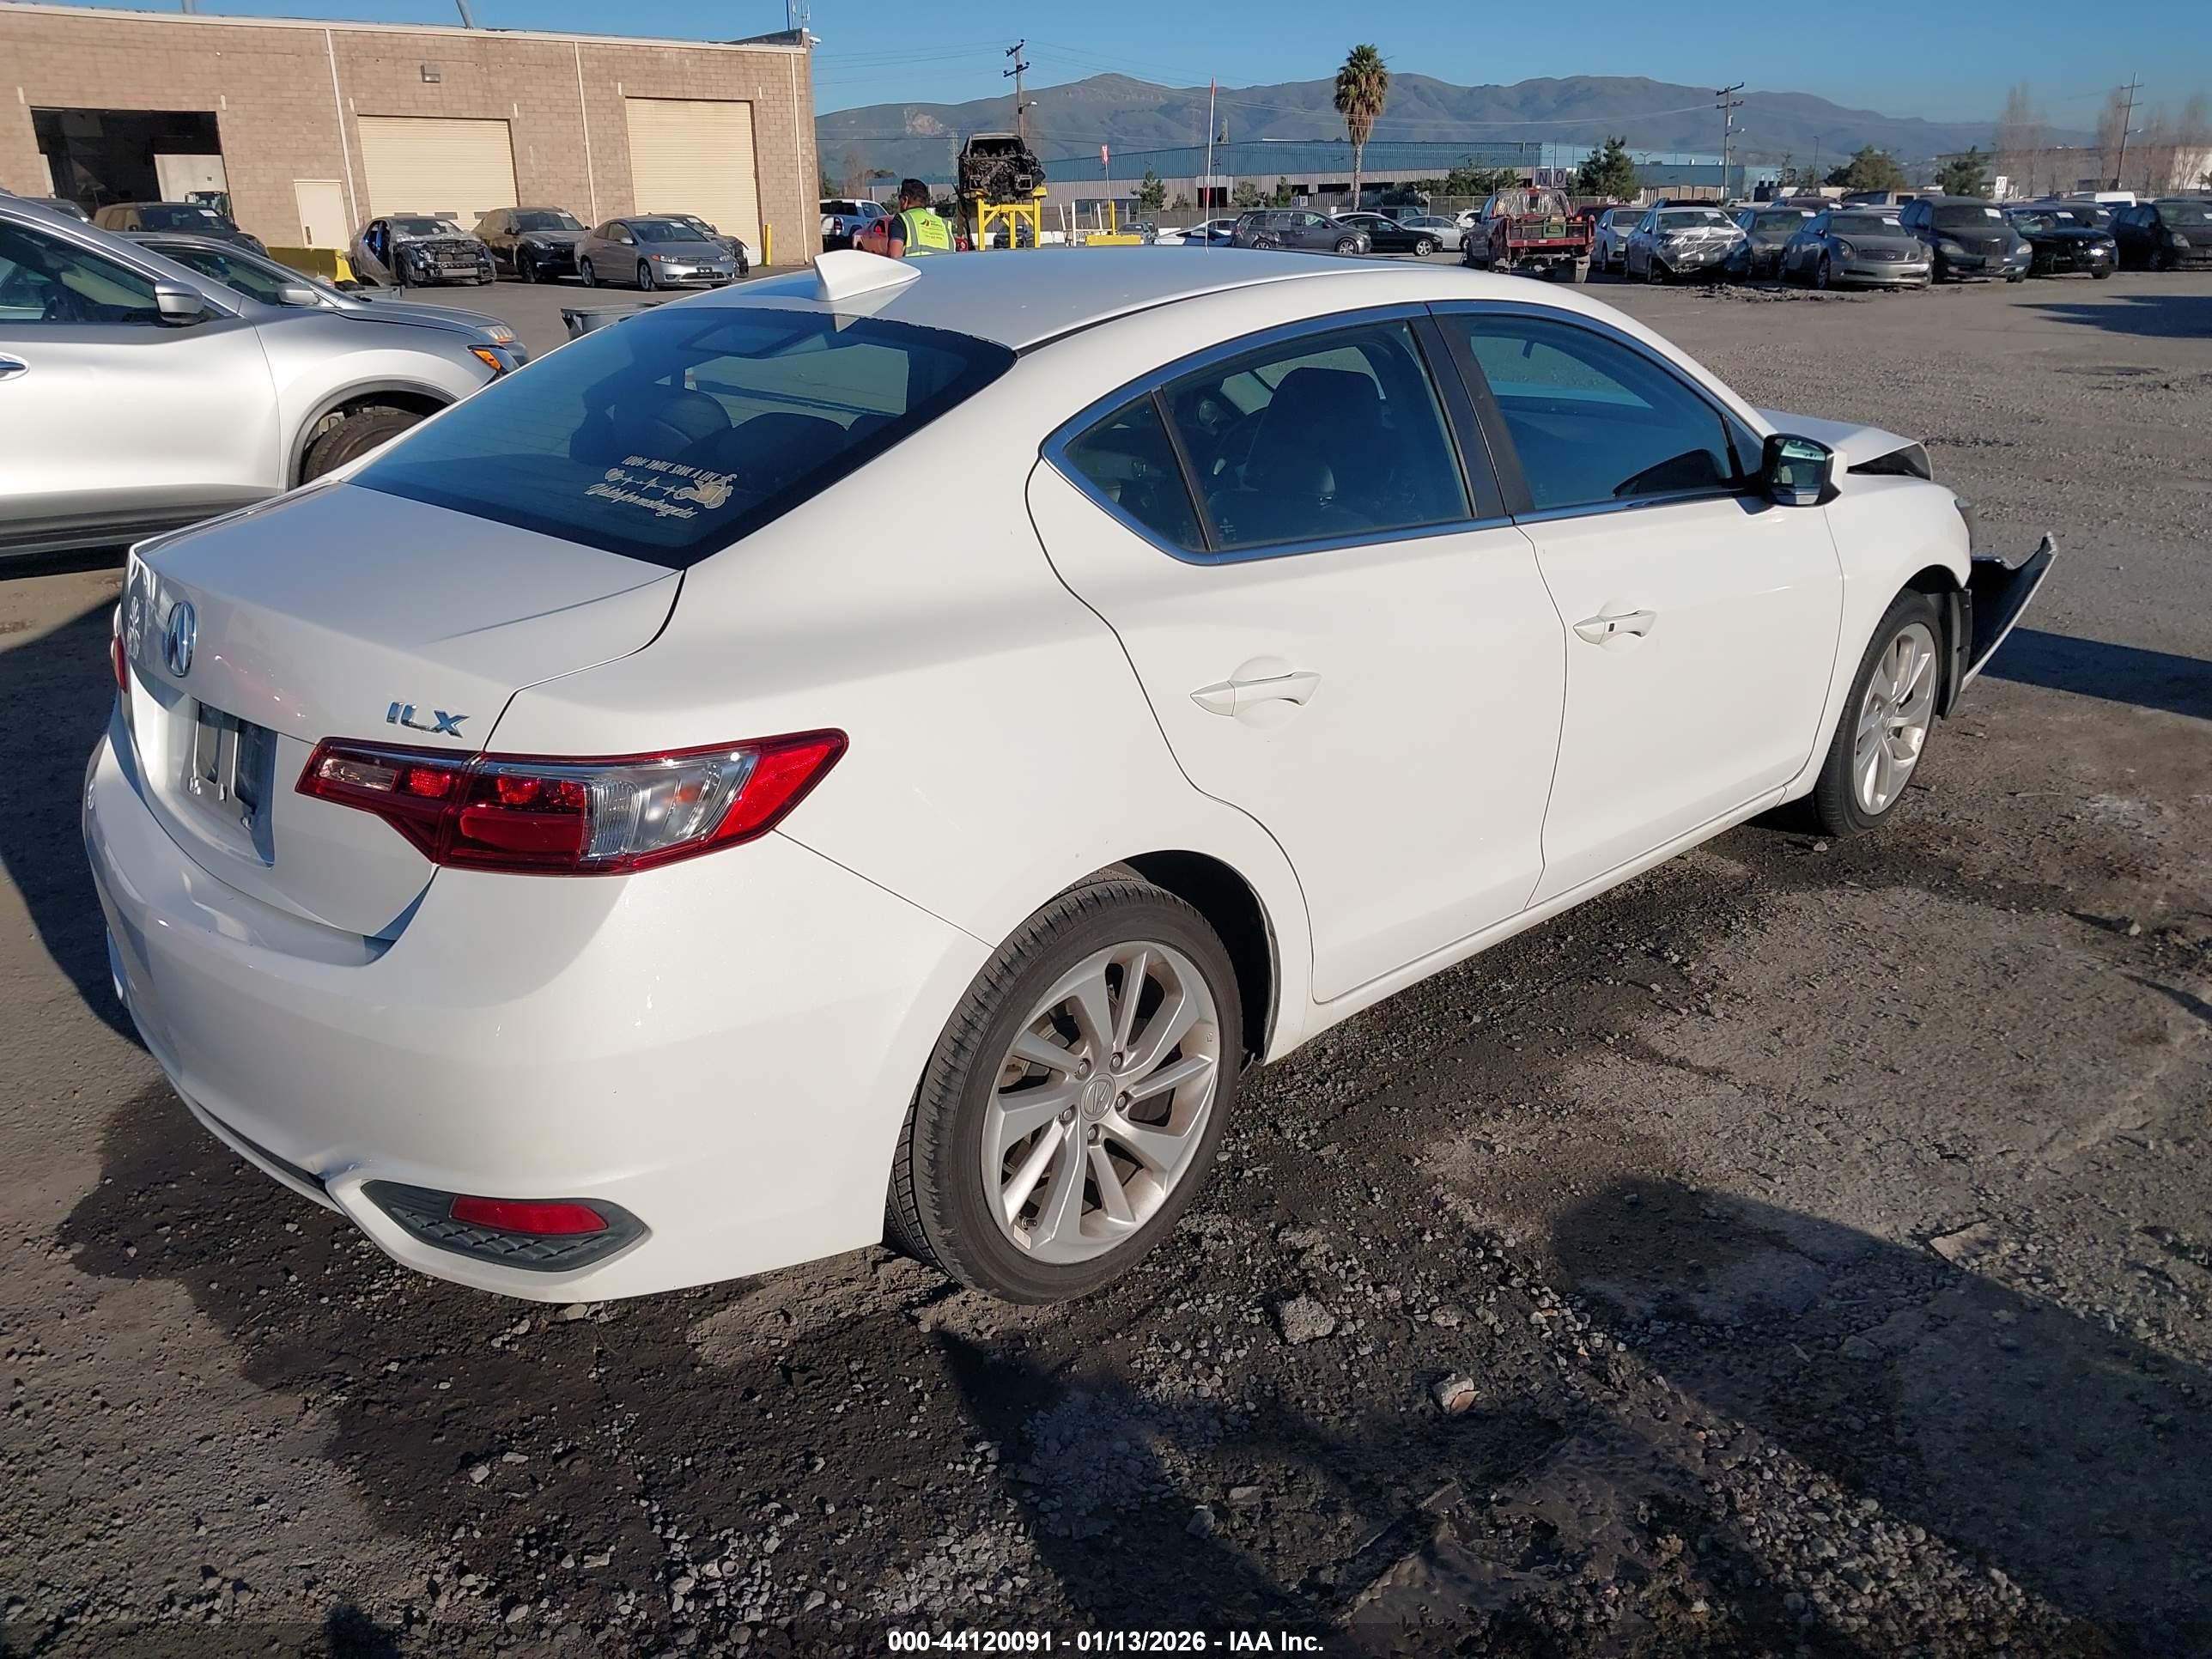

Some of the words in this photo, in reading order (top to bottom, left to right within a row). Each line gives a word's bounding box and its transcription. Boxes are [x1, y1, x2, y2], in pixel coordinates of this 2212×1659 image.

[1539, 172, 1547, 184] N
[1997, 179, 2006, 191] 20
[621, 455, 649, 466] LOOK
[645, 459, 675, 471] TWICE
[669, 464, 696, 477] SAVE
[690, 469, 703, 479] A
[633, 497, 698, 520] motorcycles
[386, 701, 471, 738] ILX
